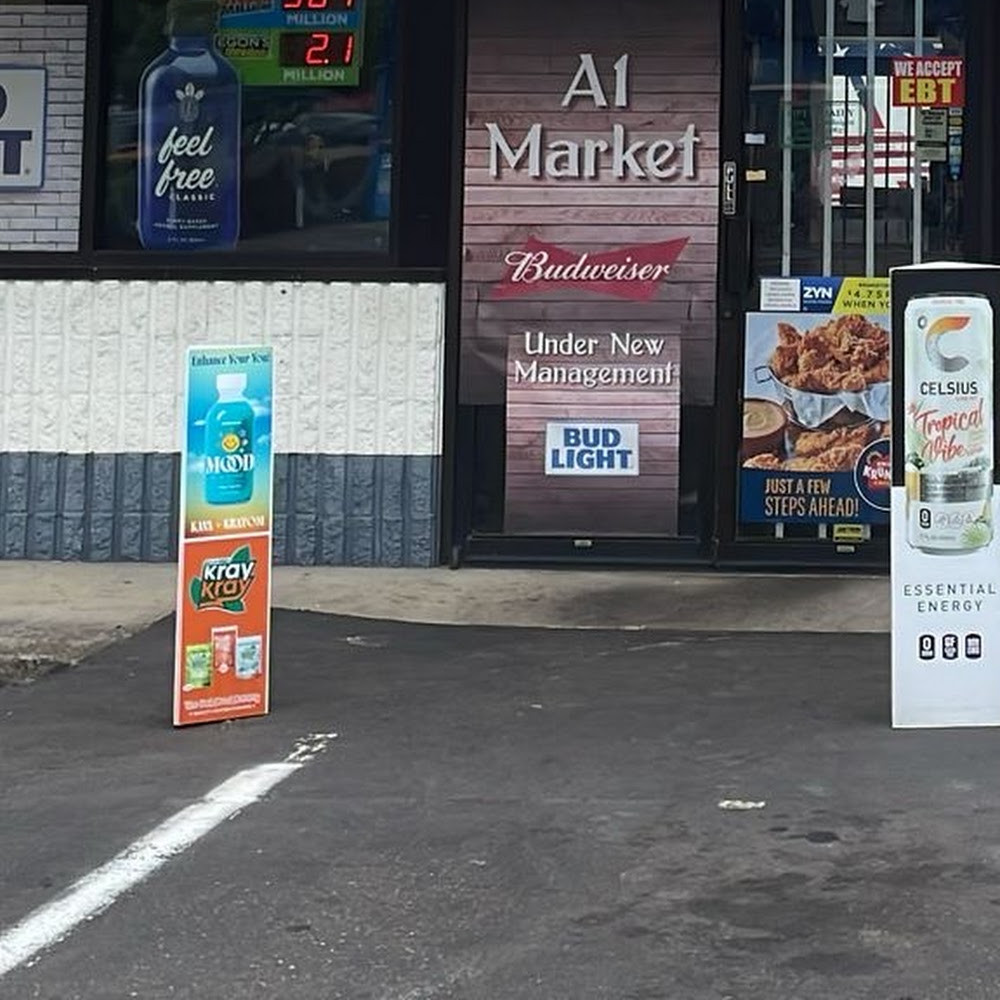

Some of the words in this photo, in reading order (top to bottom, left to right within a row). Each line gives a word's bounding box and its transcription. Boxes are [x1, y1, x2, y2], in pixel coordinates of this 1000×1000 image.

[286, 13, 348, 26] MILLION
[305, 34, 354, 64] 2.1
[282, 69, 345, 82] MILLION
[894, 60, 914, 77] WE
[916, 60, 963, 77] ACCEPT
[560, 53, 630, 108] A1
[899, 78, 957, 104] EBT
[157, 126, 214, 164] feel
[484, 122, 702, 179] Market
[154, 159, 216, 197] free
[504, 251, 671, 283] Budweiser
[803, 286, 833, 299] ZYN
[842, 300, 876, 309] WHEN
[525, 331, 598, 356] Under
[611, 332, 665, 356] New
[513, 361, 674, 388] Management
[920, 381, 978, 395] CELSIUS
[914, 397, 984, 441] Tropical
[563, 427, 622, 448] BUD
[204, 453, 256, 474] MOOD
[550, 449, 633, 470] LIGHT
[764, 478, 792, 495] JUST
[795, 478, 803, 495] A
[807, 478, 831, 495] FEW
[764, 497, 806, 517] STEPS
[808, 497, 860, 517] AHEAD!
[903, 583, 997, 597] ESSENTIAL
[917, 600, 984, 613] ENERGY
